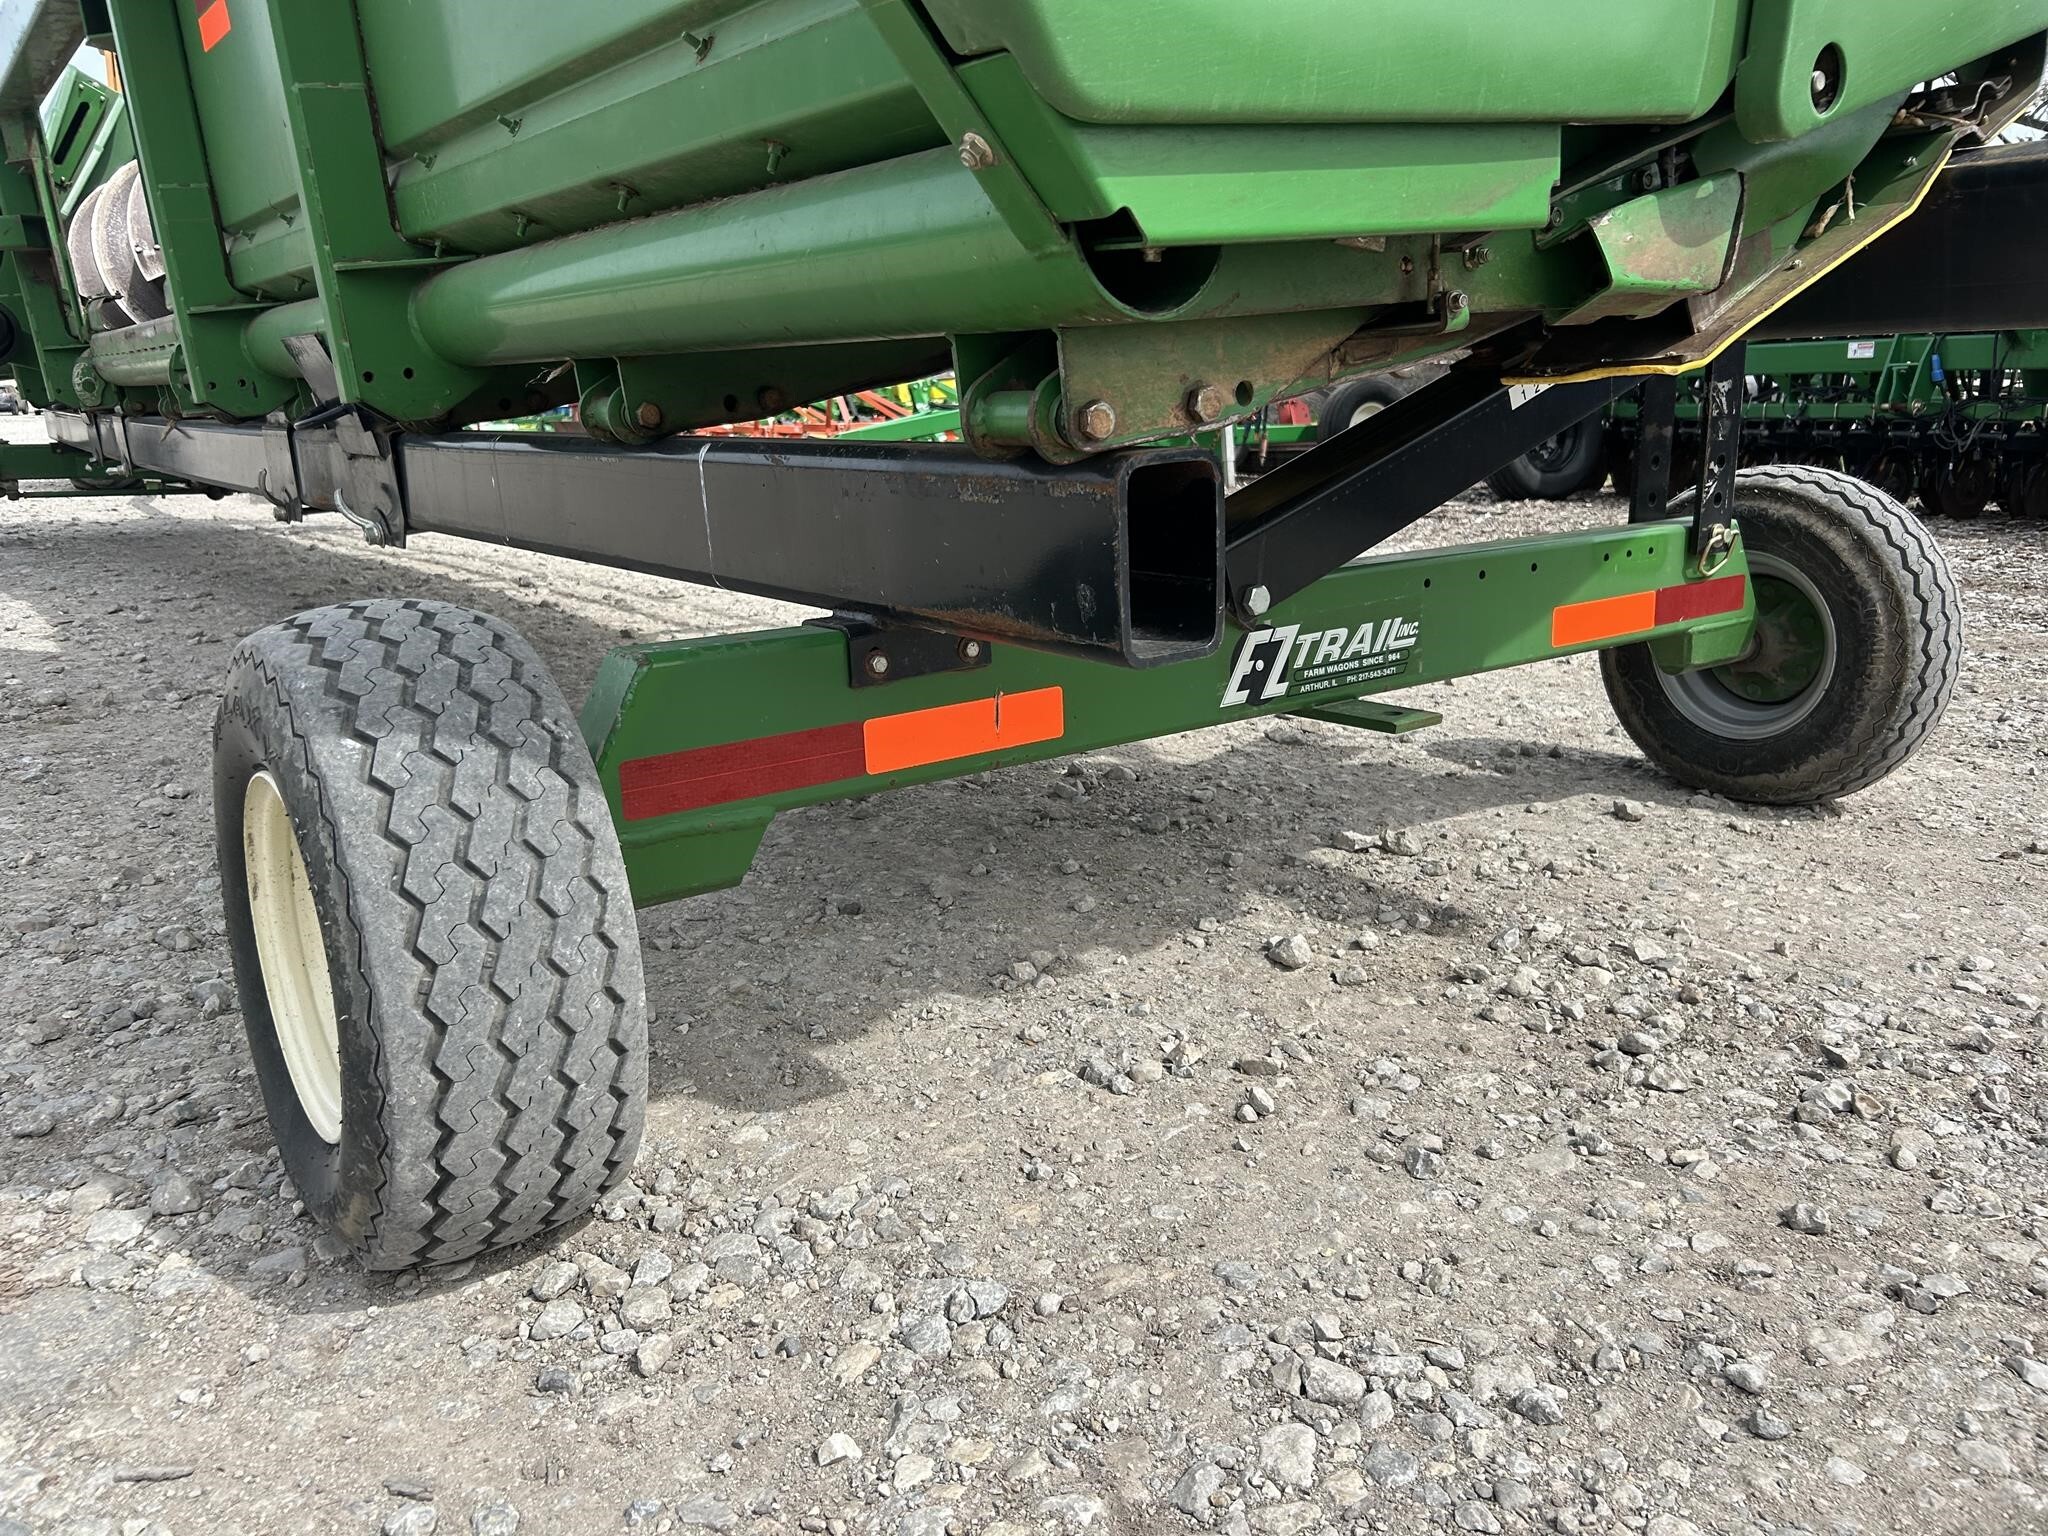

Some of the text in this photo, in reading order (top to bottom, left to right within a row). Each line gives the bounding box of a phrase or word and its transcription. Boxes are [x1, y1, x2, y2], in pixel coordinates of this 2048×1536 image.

[1294, 617, 1417, 669] TRAIL
[1396, 621, 1419, 638] INC.
[1304, 652, 1400, 678] FARM WAGONS SINCE 964
